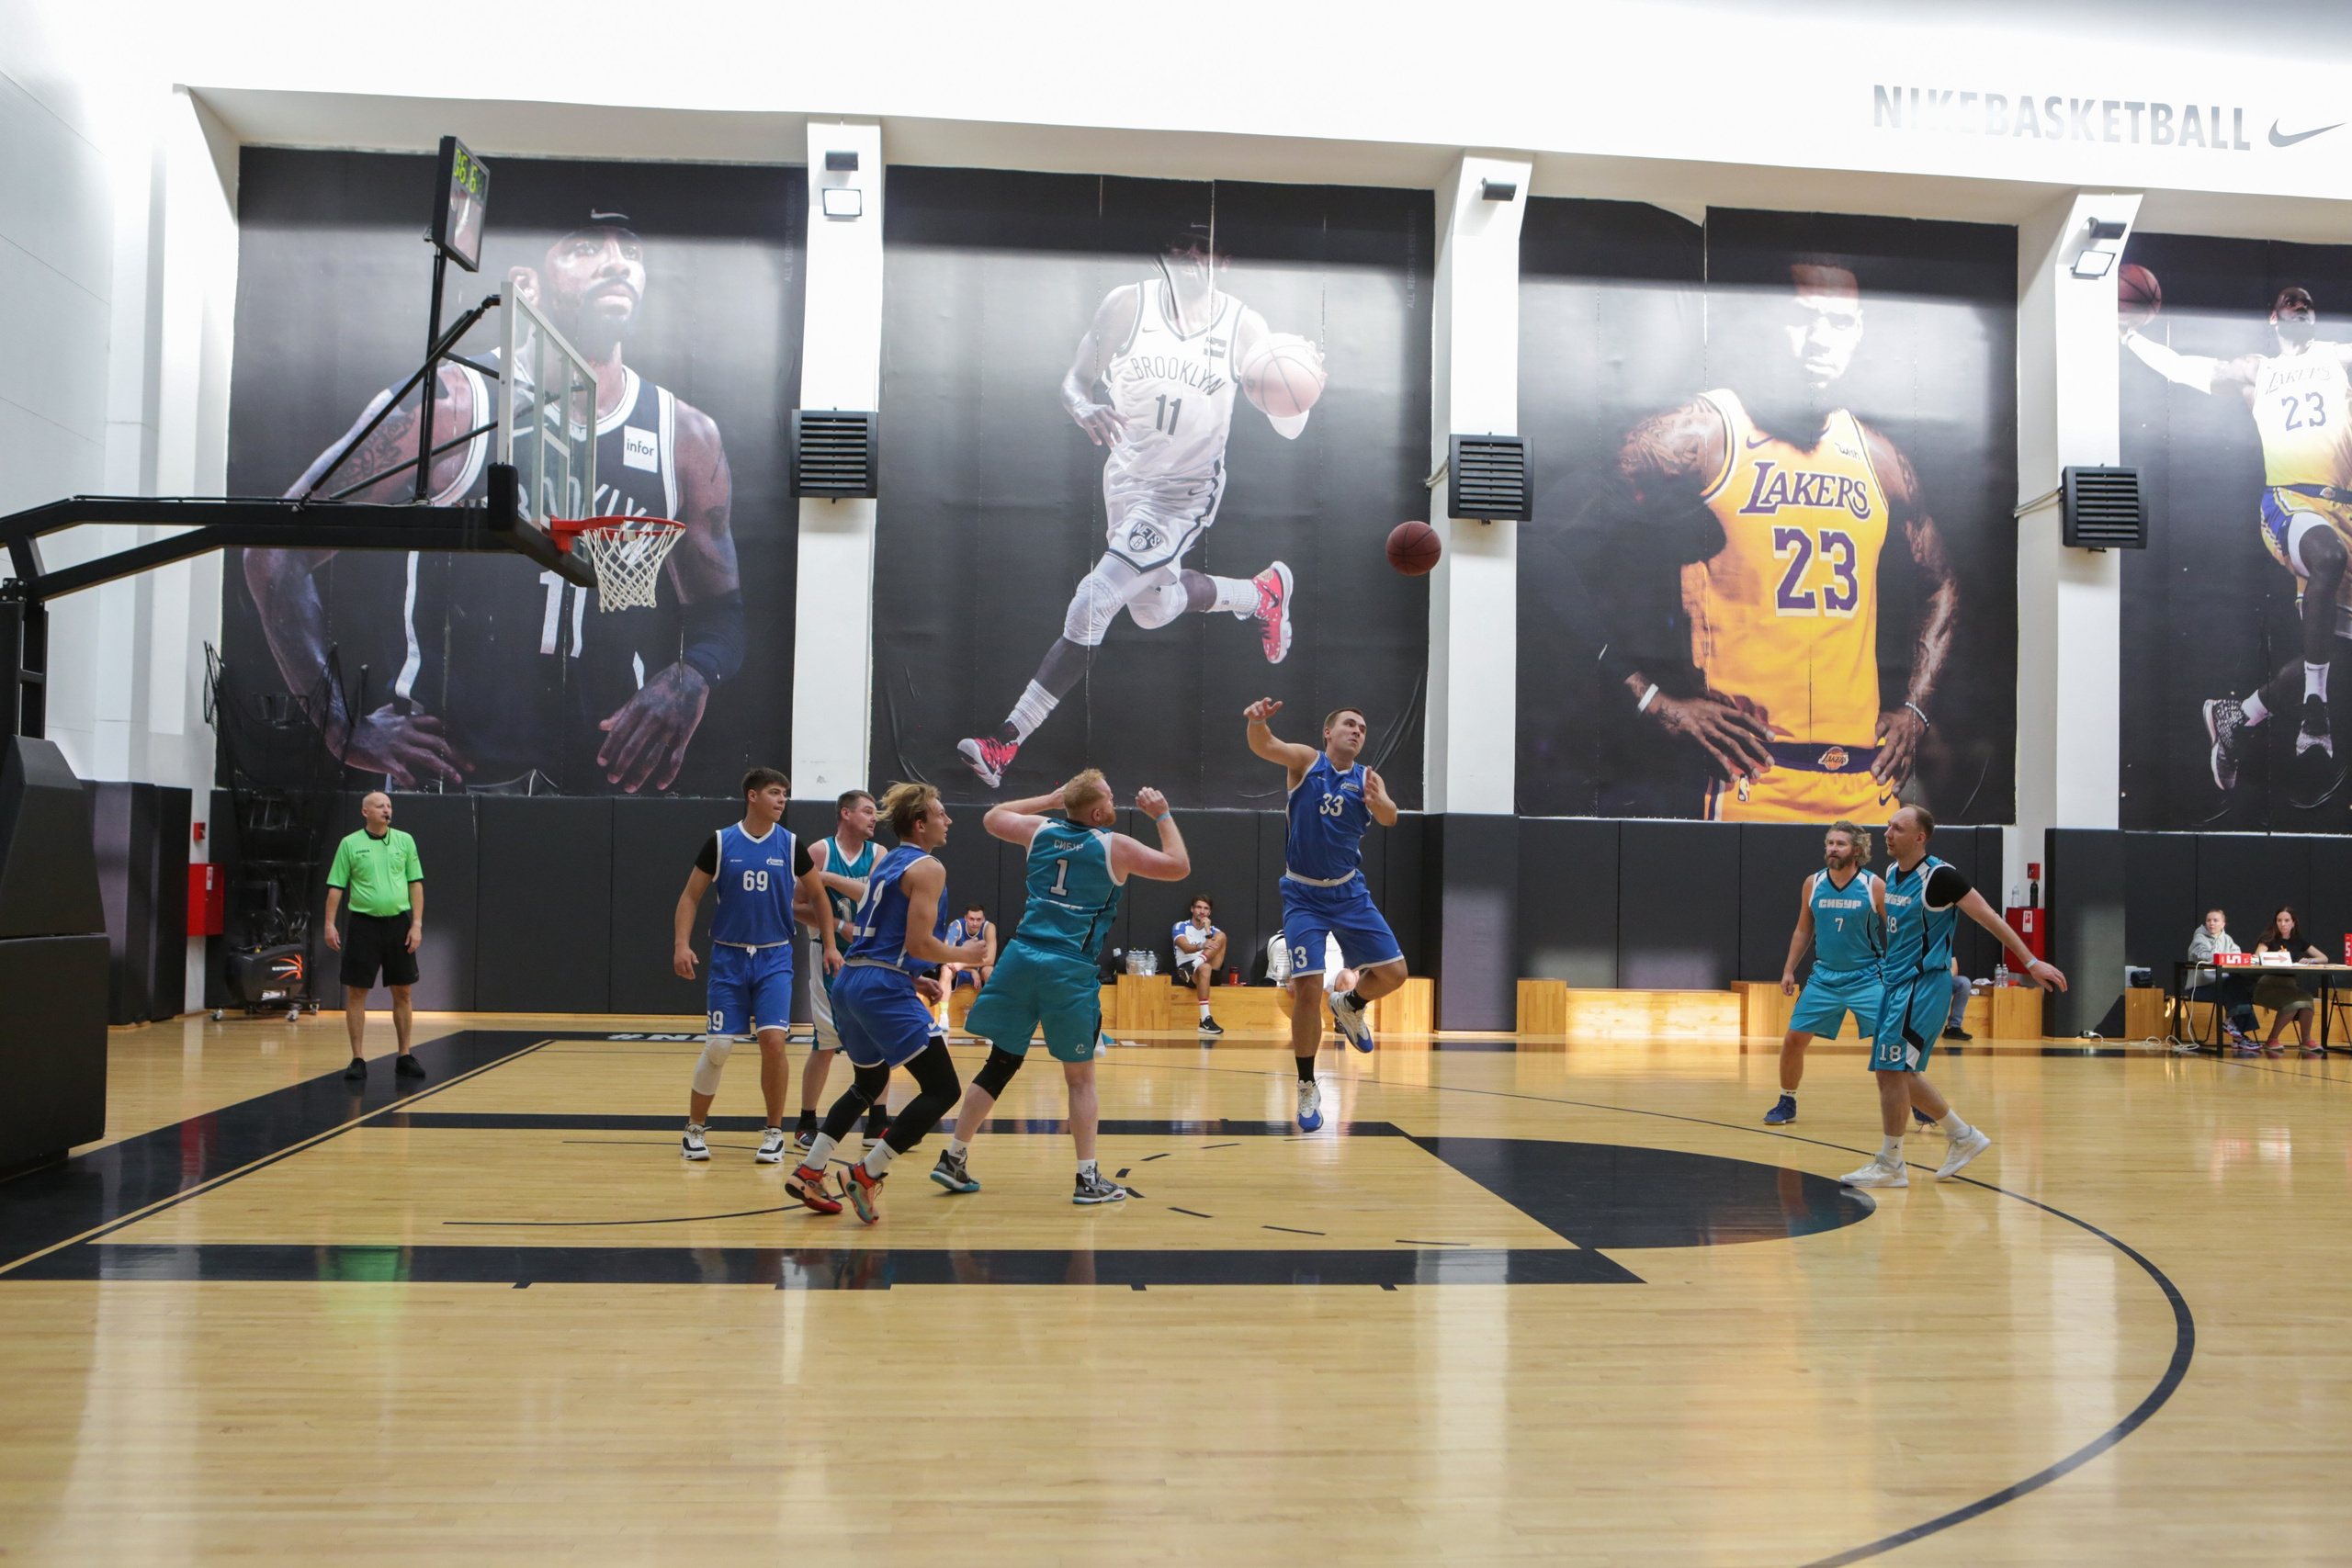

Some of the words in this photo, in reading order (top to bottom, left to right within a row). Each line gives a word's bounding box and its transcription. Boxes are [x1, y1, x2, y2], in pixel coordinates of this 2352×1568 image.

[1130, 355, 1227, 396] BROOKLYN
[1155, 394, 1182, 436] 11
[2280, 391, 2327, 432] 23
[626, 438, 655, 457] infor
[1737, 461, 1871, 520] LAKERS
[1132, 523, 1160, 547] NETS
[1772, 526, 1860, 618] 23
[1319, 793, 1344, 817] 33
[742, 869, 768, 892] 69
[1050, 858, 1069, 897] 1
[1818, 898, 1861, 909] СИБУР
[1835, 918, 1844, 932] 7
[1879, 1043, 1902, 1062] 18
